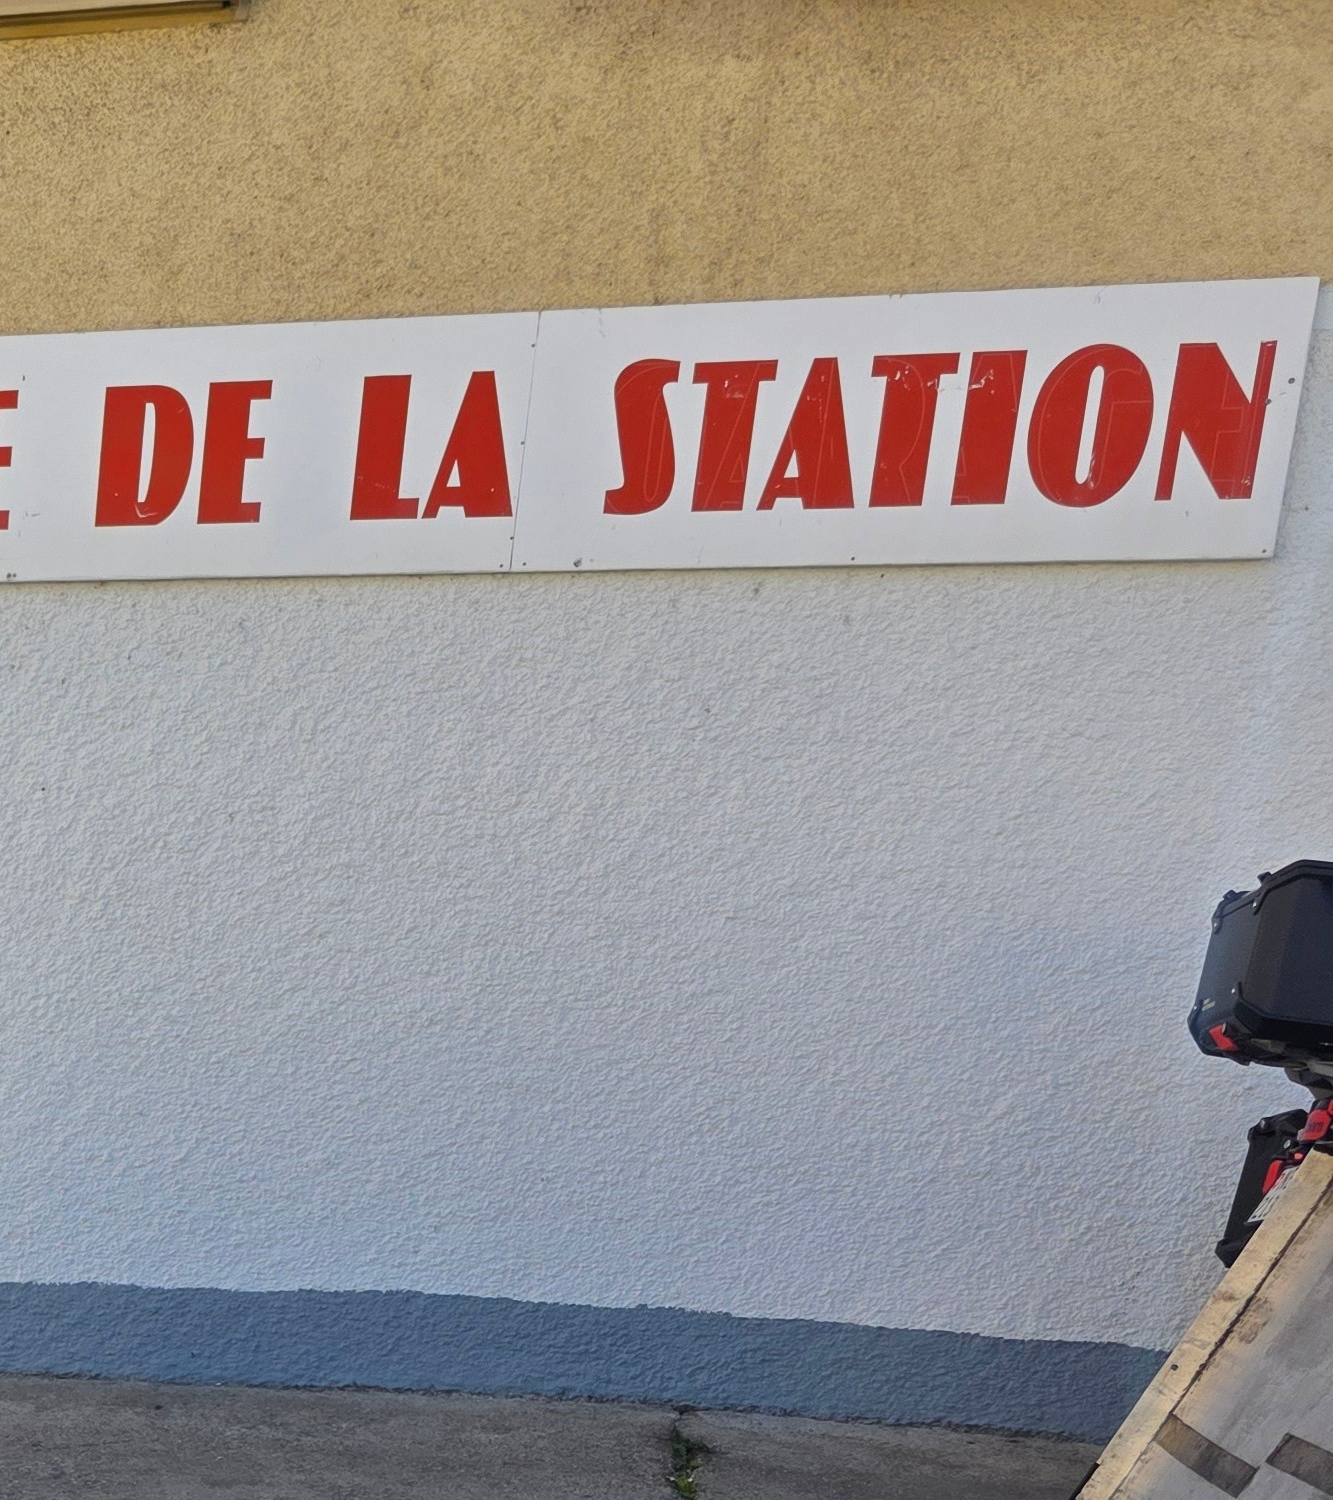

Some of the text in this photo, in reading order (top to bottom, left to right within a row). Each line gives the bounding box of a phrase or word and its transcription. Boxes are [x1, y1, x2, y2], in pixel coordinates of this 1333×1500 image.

[96, 381, 271, 527] DE
[351, 371, 511, 520] LA
[605, 342, 1276, 516] STATION
